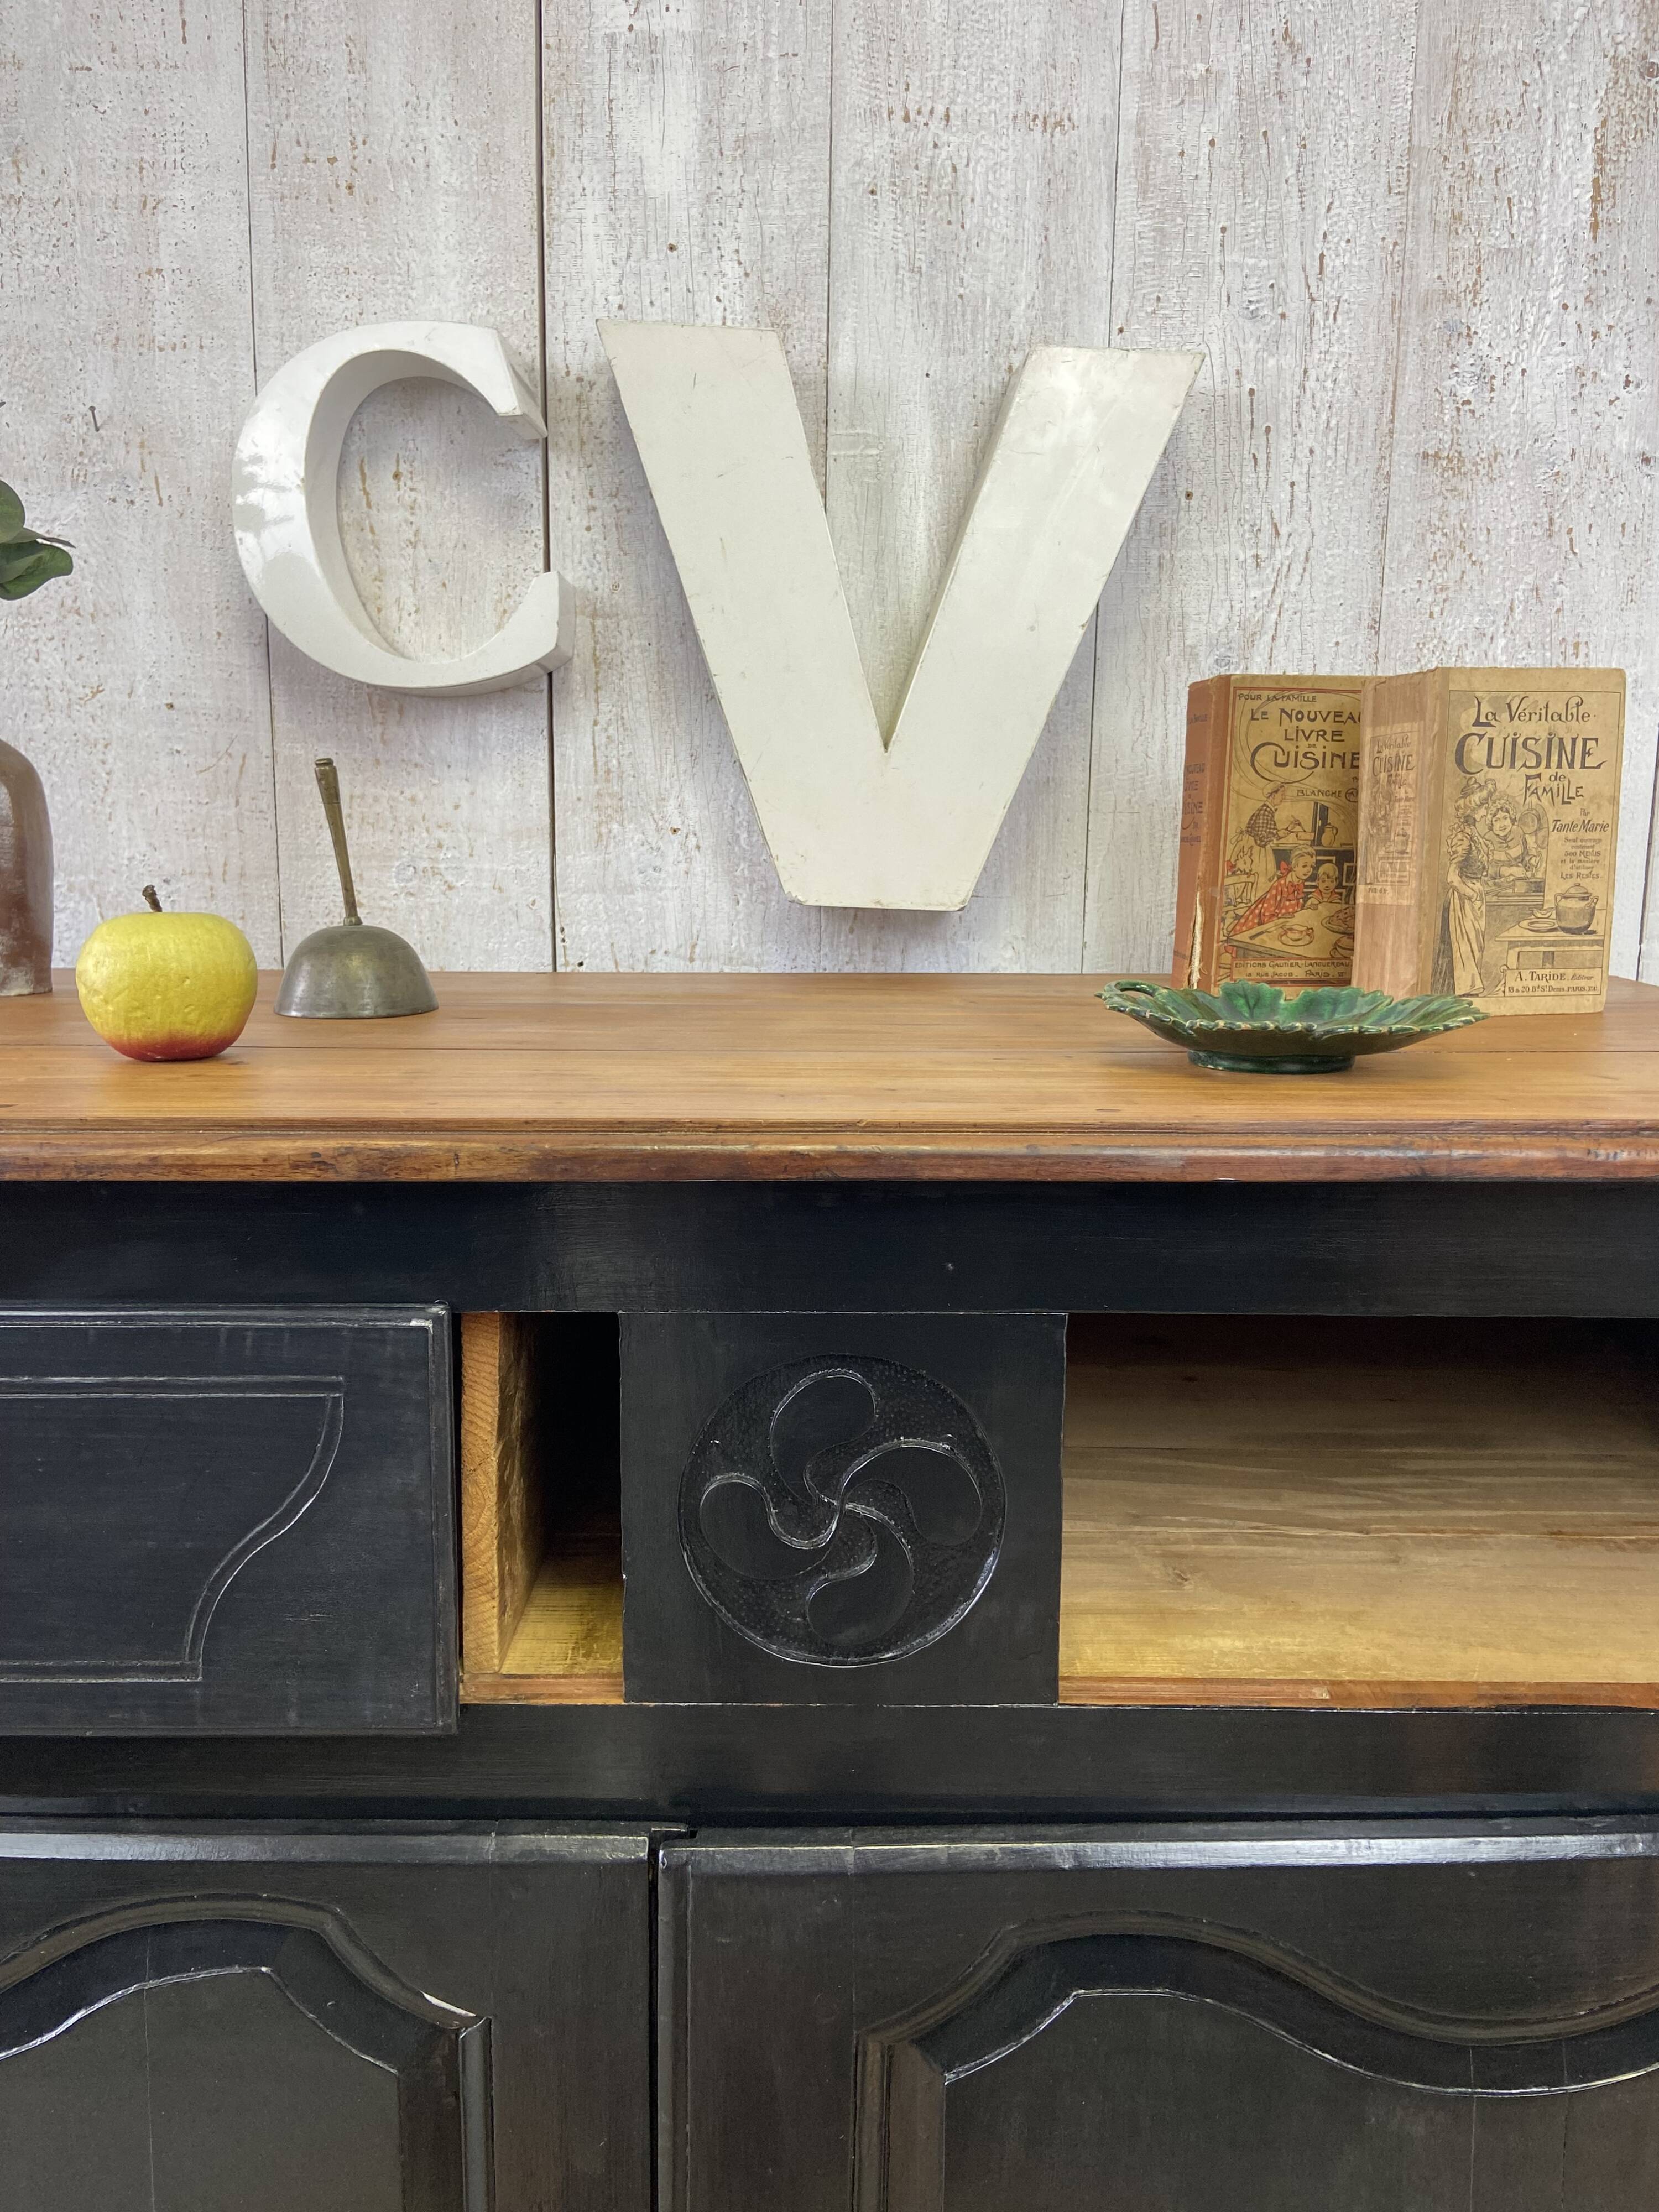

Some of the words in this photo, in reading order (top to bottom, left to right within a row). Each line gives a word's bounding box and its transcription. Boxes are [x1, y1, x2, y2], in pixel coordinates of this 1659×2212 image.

[1281, 695, 1317, 703] FAMILLE
[1250, 708, 1269, 721] LE
[1472, 696, 1501, 728] La
[1505, 695, 1590, 724] Véritable
[1284, 726, 1345, 743] LIVRE
[1454, 731, 1608, 775] CUISINE
[1250, 742, 1360, 784] CUISINE
[1372, 752, 1416, 777] CUISINE
[1548, 771, 1567, 782] de
[1296, 789, 1342, 798] BLANCHE
[1523, 773, 1584, 807] FAMILLE
[1551, 819, 1578, 833] Tante
[1578, 818, 1610, 833] Marie
[1305, 969, 1331, 978] PARIS
